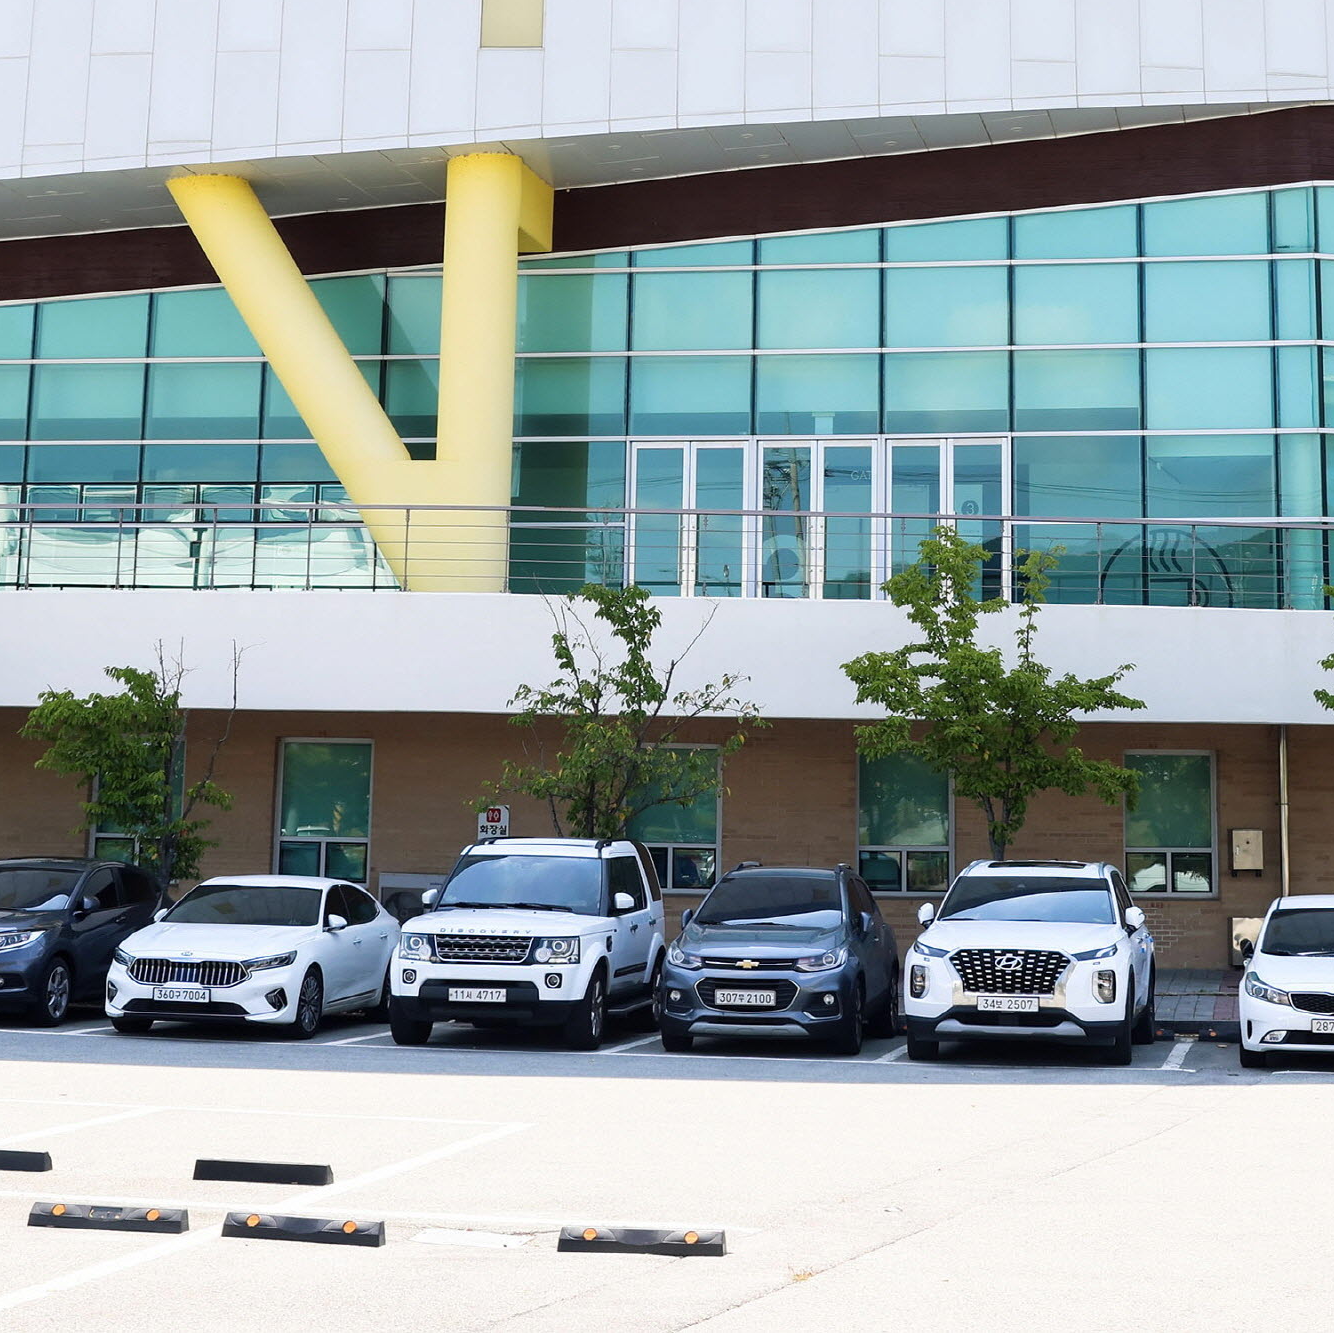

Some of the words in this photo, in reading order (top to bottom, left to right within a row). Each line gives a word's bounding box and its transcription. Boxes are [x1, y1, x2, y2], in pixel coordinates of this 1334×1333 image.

[966, 503, 975, 515] 3
[480, 825, 507, 836] 화장실
[183, 990, 206, 1001] 7004
[476, 990, 501, 1000] 4717
[746, 994, 772, 1004] 2100
[1007, 999, 1033, 1010] 2507
